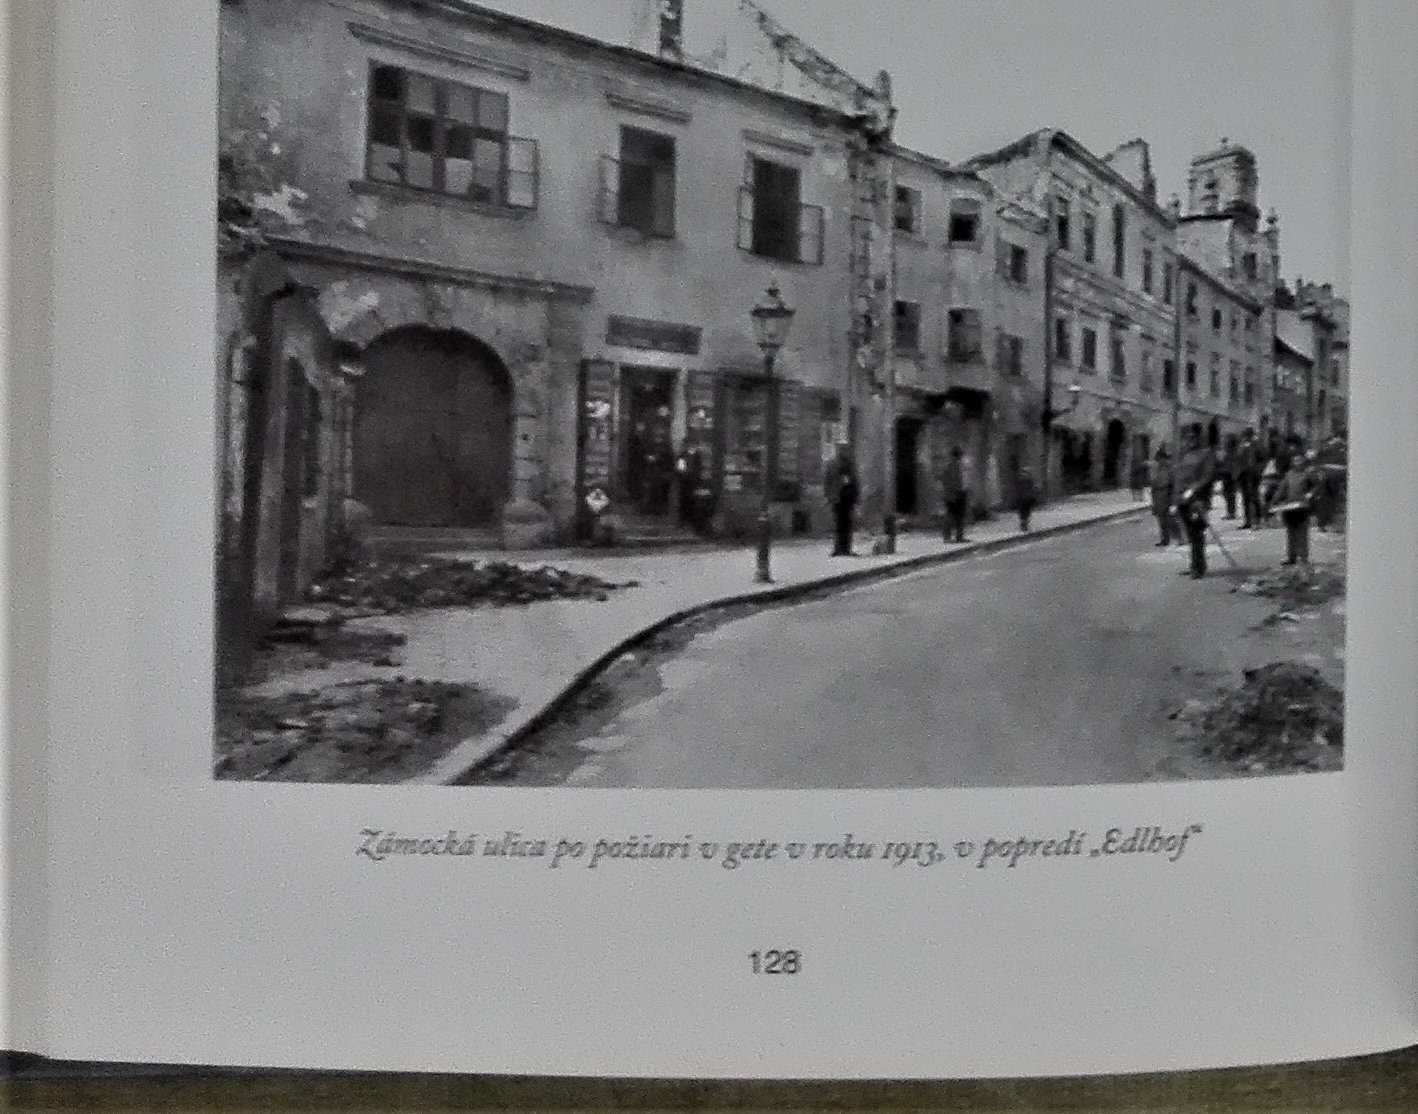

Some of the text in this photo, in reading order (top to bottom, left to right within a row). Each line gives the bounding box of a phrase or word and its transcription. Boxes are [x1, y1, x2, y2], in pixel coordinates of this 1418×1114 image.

[354, 827, 478, 862] Zámocká
[481, 829, 549, 858] ulica
[548, 837, 588, 869] po
[586, 833, 693, 870] požiari
[697, 840, 720, 860] v
[720, 837, 781, 871] gete
[783, 841, 808, 860] v
[811, 832, 876, 860] roku
[879, 840, 947, 868] 1913,
[952, 839, 976, 859] v
[747, 949, 802, 976] 128
